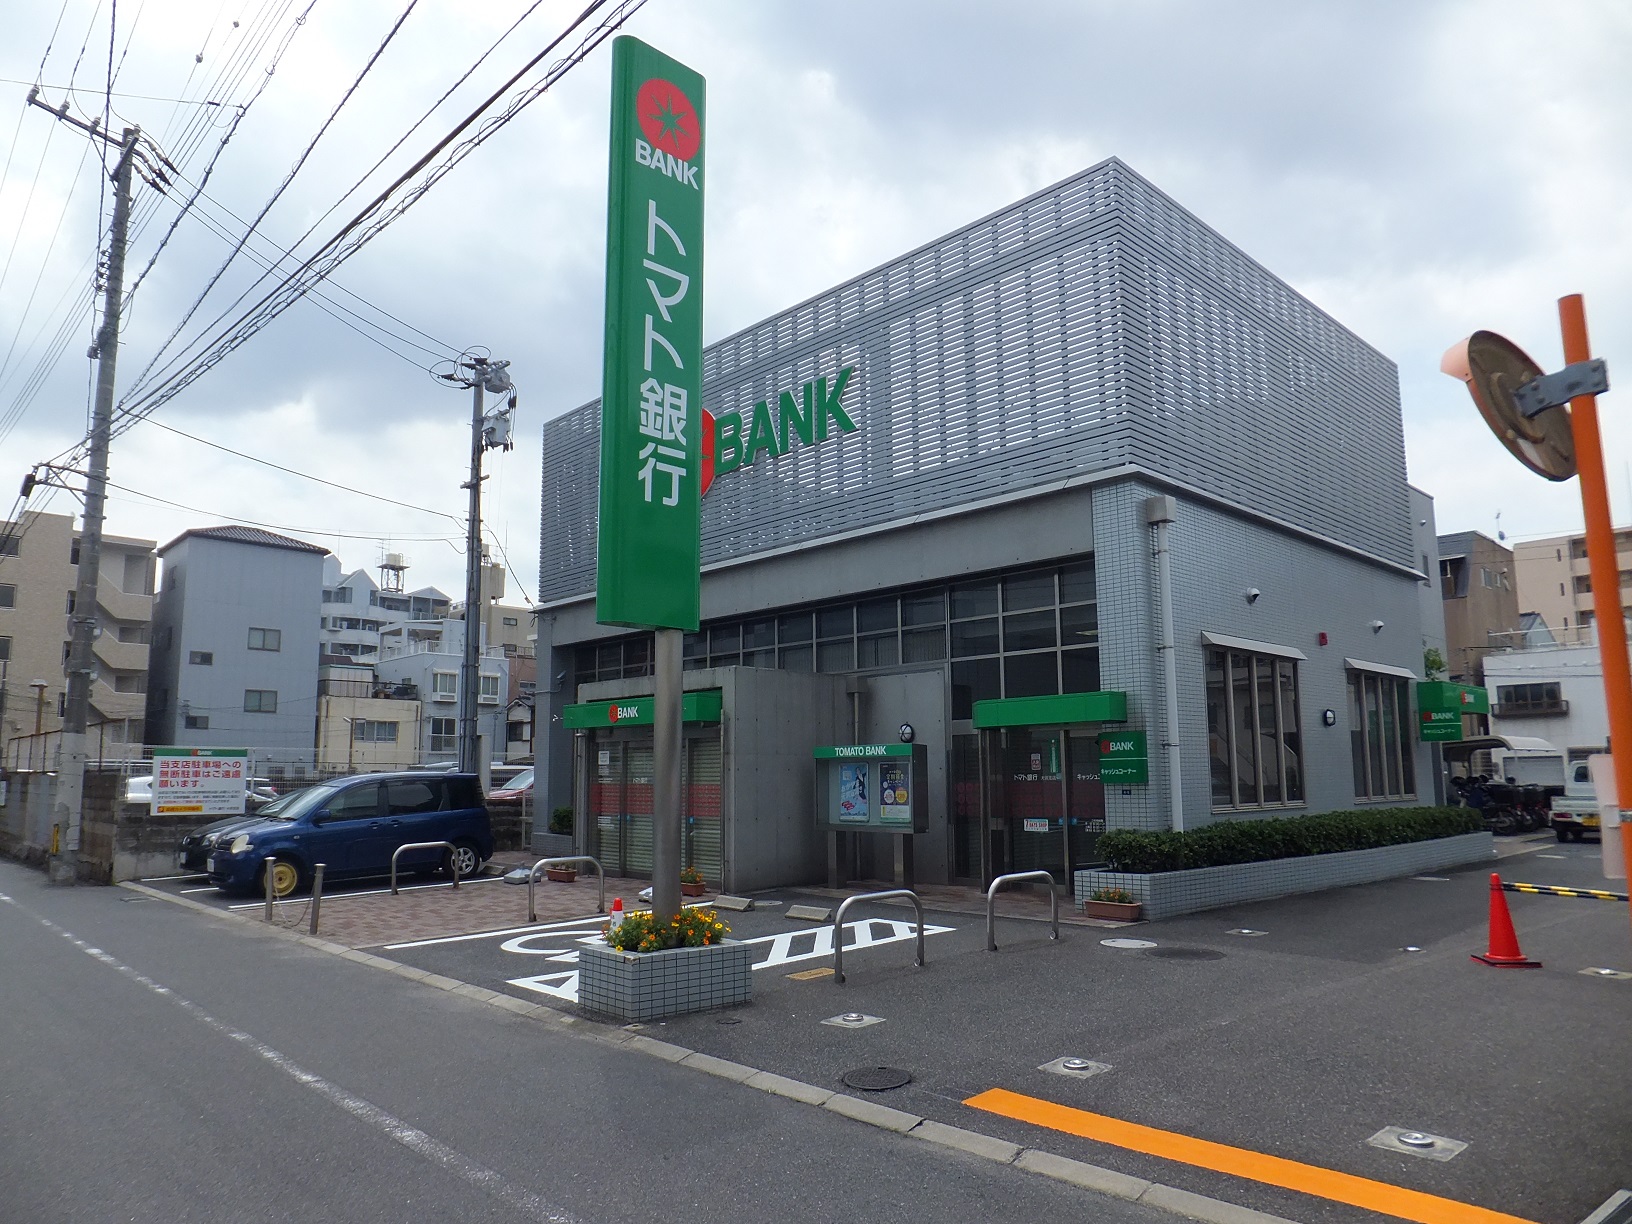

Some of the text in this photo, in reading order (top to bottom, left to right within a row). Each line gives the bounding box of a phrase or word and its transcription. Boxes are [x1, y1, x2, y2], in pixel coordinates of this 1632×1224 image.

[635, 138, 699, 190] BANK
[638, 199, 690, 507] トマト銀行
[714, 365, 860, 477] BANK
[617, 706, 638, 718] BANK
[1431, 712, 1454, 720] BANK
[835, 746, 886, 756] TOMATO BANK
[1109, 741, 1134, 751] BANK
[160, 760, 241, 769] 当支店駐車場への
[159, 770, 241, 778] 無断駐車はご遠慮
[1013, 773, 1038, 781] トマト銀行
[159, 780, 204, 788] 願います。
